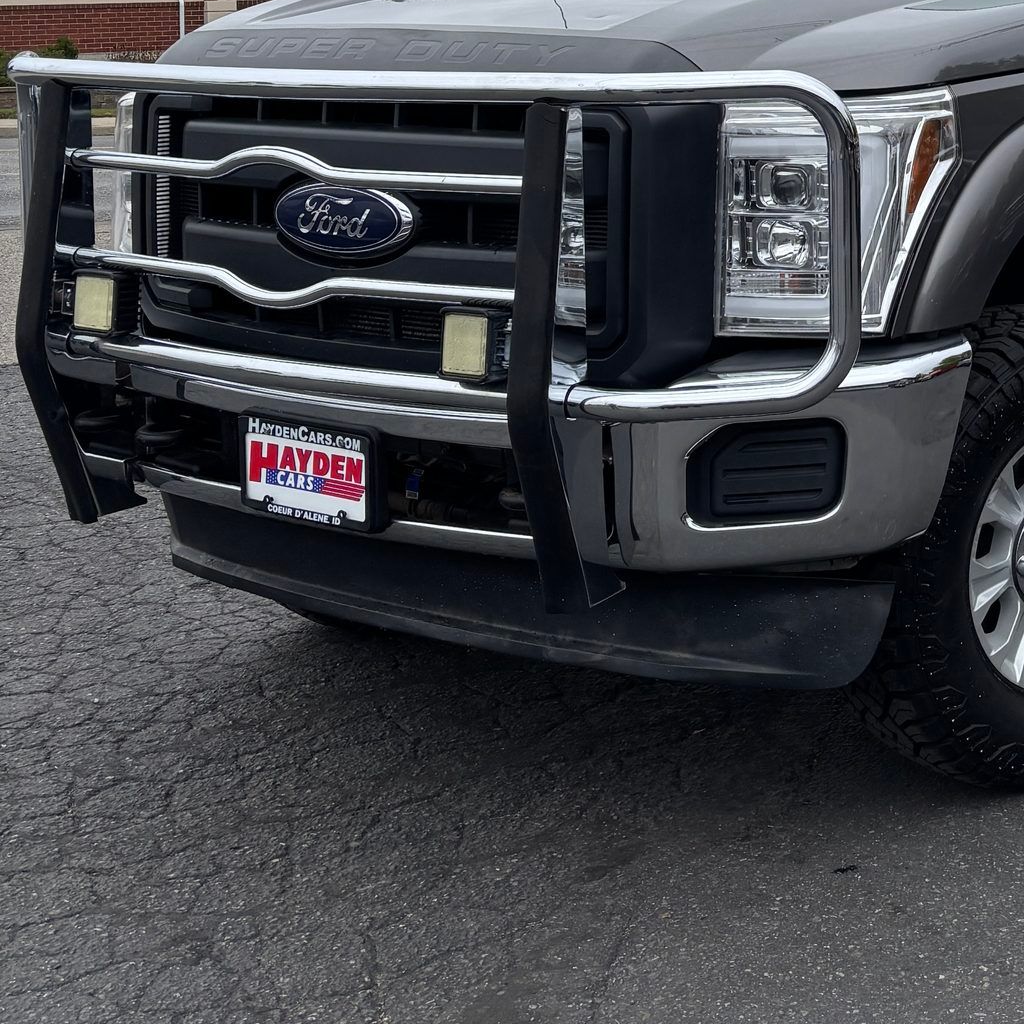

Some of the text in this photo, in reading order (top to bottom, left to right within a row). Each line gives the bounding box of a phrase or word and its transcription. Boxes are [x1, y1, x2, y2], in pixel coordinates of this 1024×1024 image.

[204, 36, 578, 68] SUPER DUTY
[296, 192, 372, 240] Ford
[249, 440, 364, 484] HAYDEN
[276, 471, 314, 491] CARS
[267, 503, 293, 517] COEUR
[331, 516, 341, 525] ID
